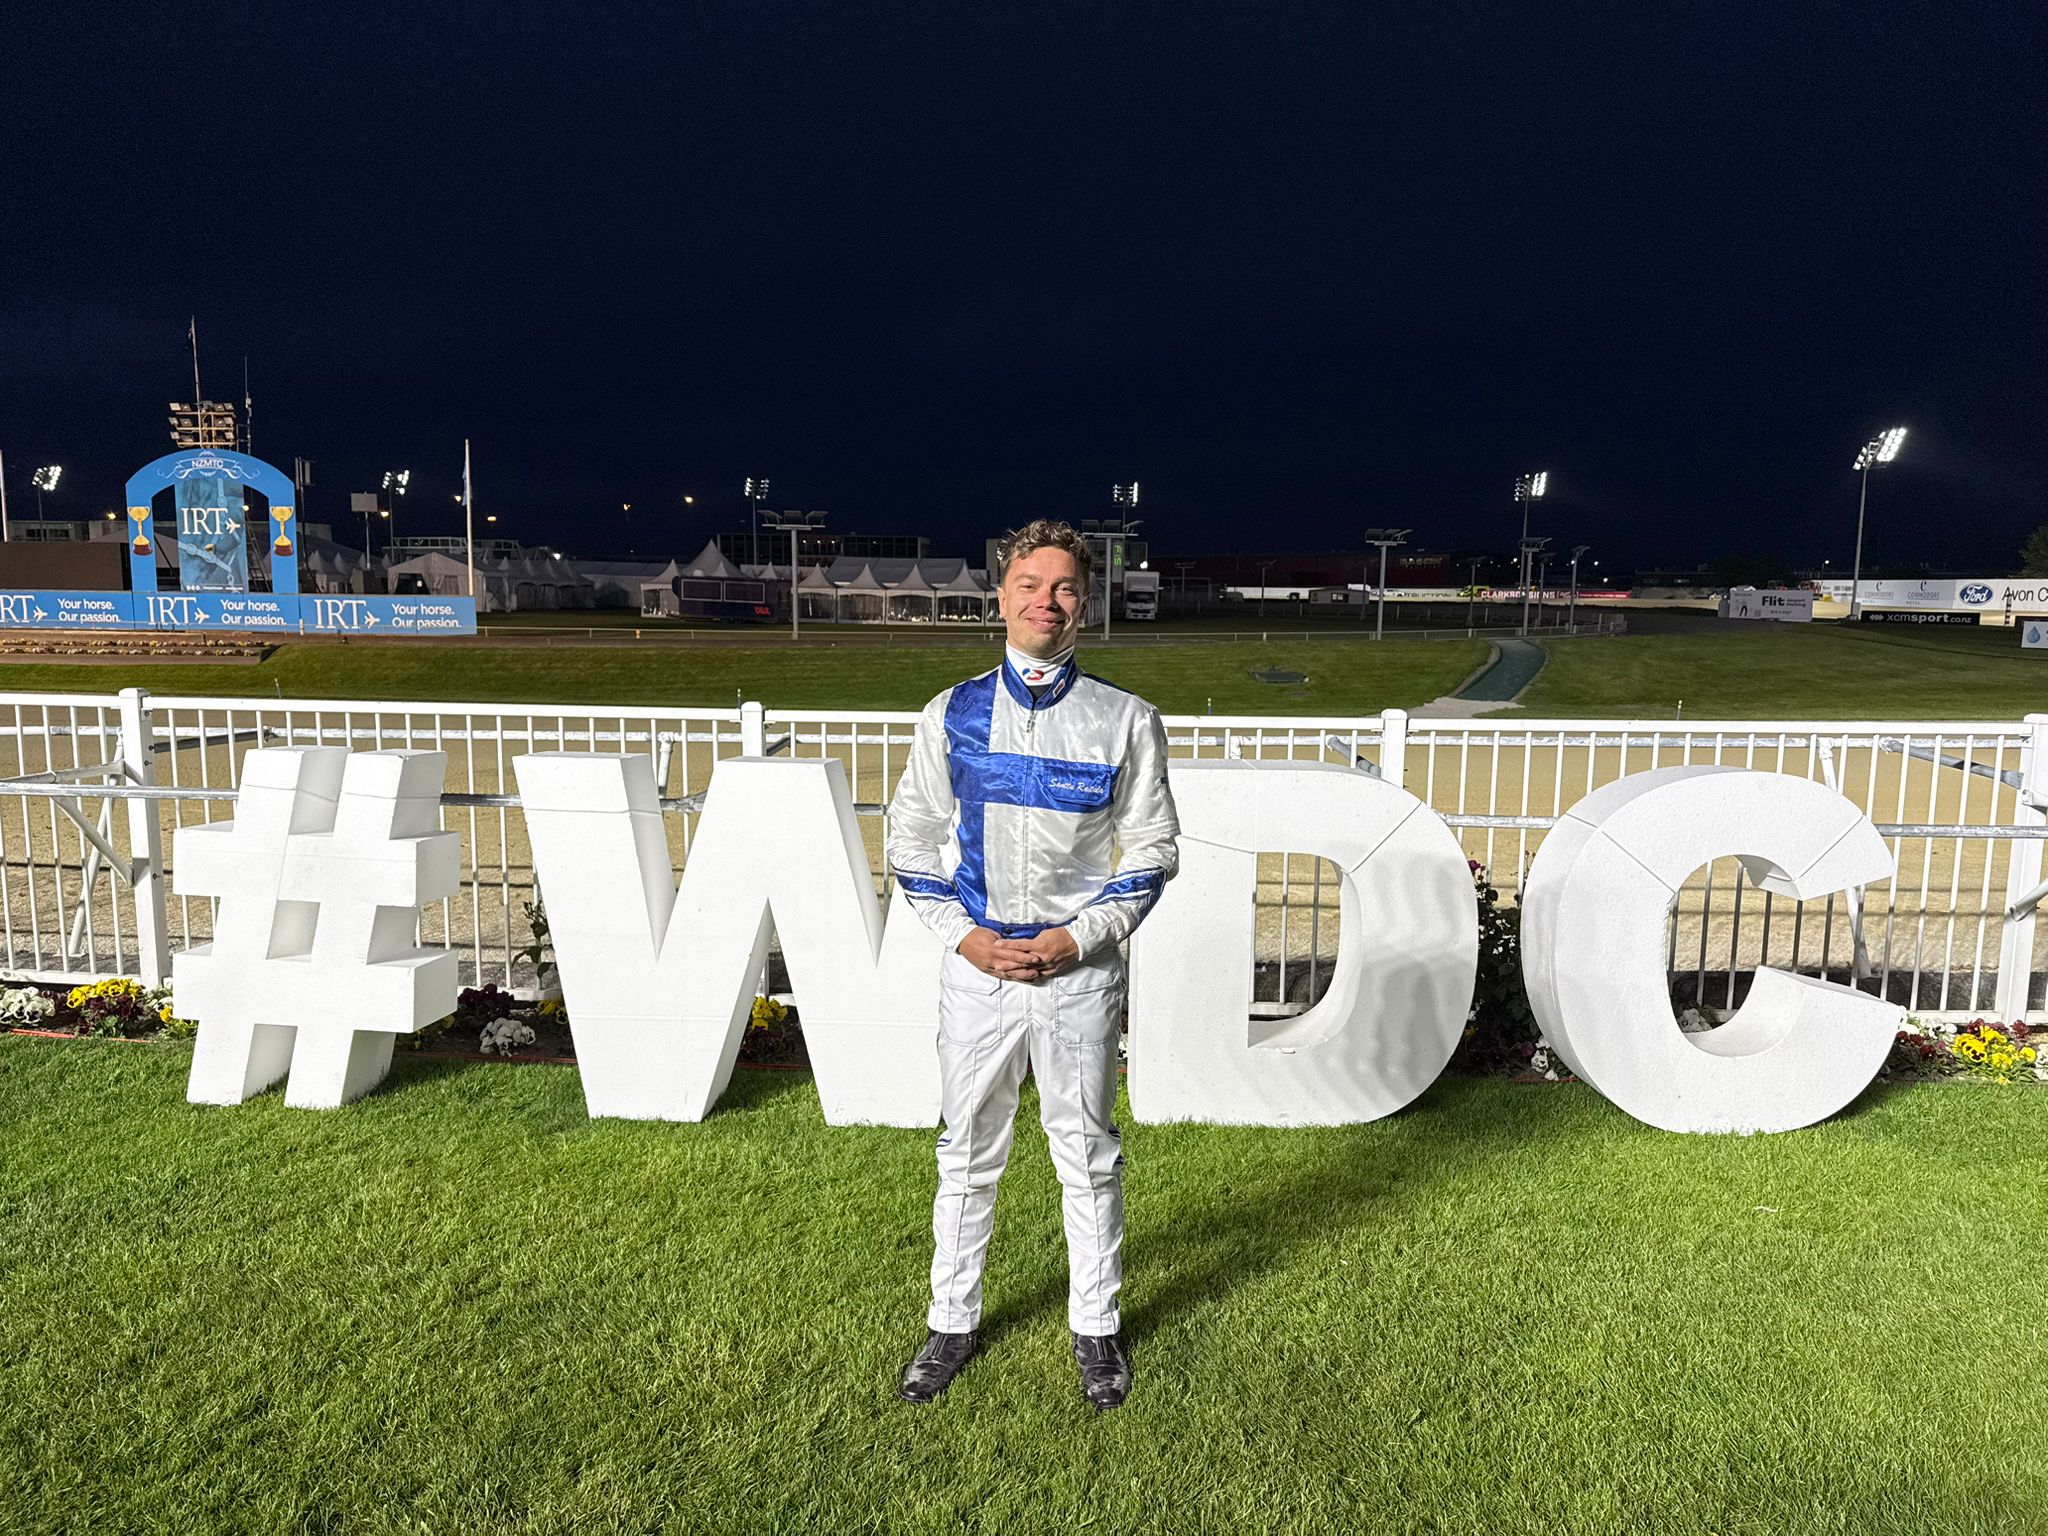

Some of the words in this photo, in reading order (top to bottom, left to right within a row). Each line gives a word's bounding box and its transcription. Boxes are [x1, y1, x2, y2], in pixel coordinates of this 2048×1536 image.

[192, 460, 224, 468] NZMTC
[181, 507, 229, 535] IRT
[1963, 584, 1989, 603] Ford
[2002, 586, 2034, 602] Avon
[58, 598, 81, 610] Your
[83, 598, 115, 610] horse.
[220, 599, 245, 611] Your
[247, 599, 280, 611] horse.
[1762, 596, 1785, 606] Flit
[146, 596, 197, 625] IRT
[313, 599, 367, 629] IRT
[391, 603, 418, 615] Your
[421, 603, 455, 615] horse.
[59, 611, 78, 622] Our
[80, 612, 122, 624] passion.
[221, 613, 241, 625] Our
[244, 614, 287, 626] passion.
[392, 617, 413, 628] Our
[416, 618, 462, 630] passion.
[1887, 613, 1972, 624] xcmsport.co.nz
